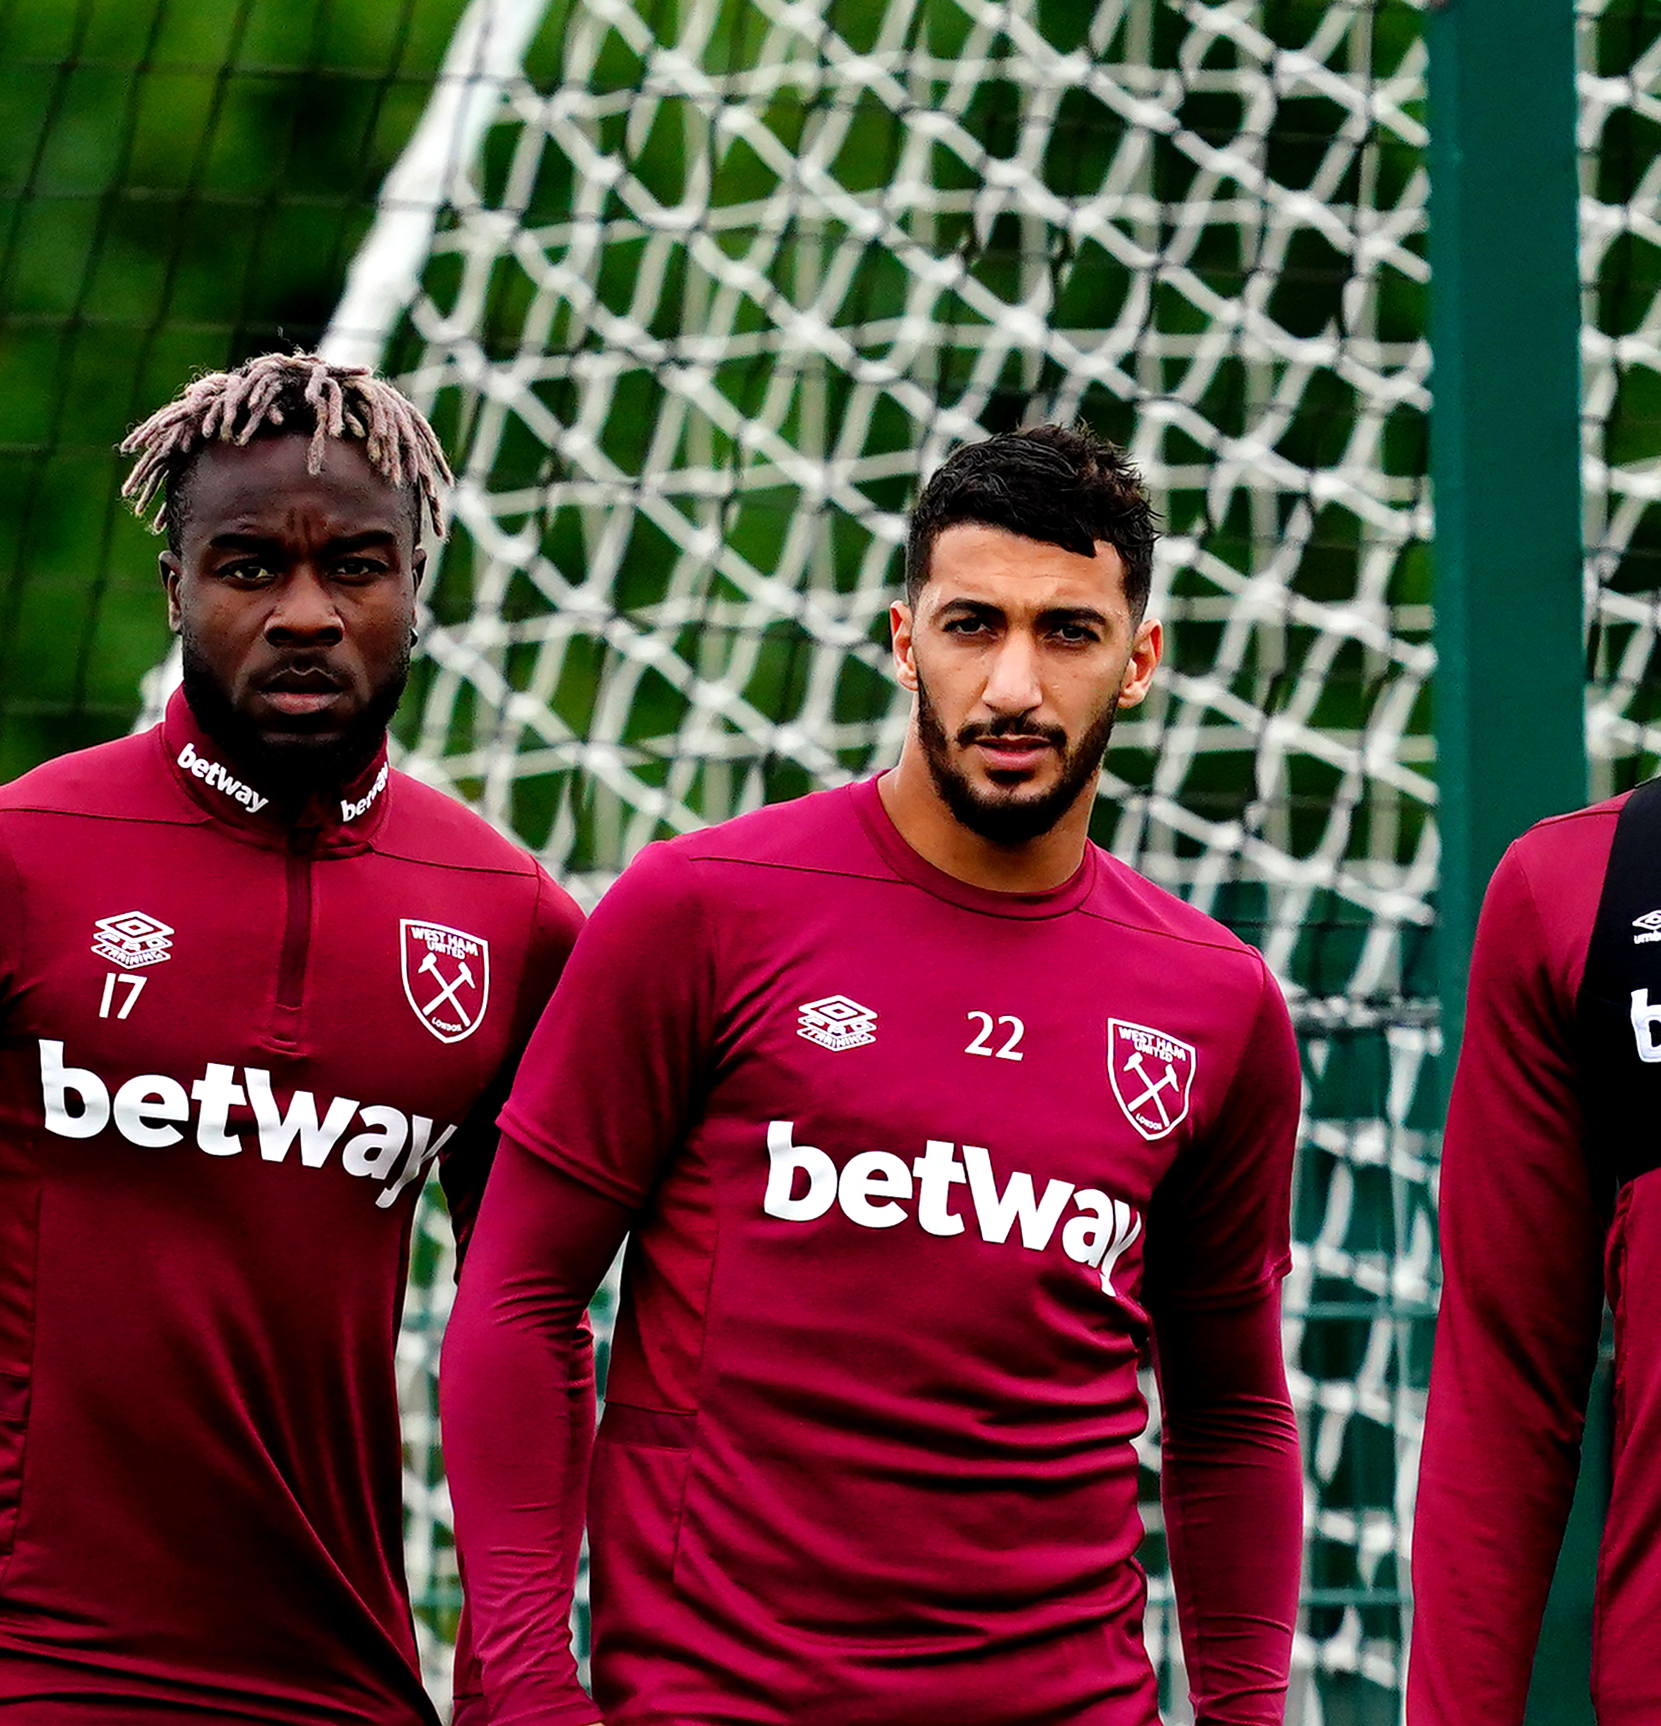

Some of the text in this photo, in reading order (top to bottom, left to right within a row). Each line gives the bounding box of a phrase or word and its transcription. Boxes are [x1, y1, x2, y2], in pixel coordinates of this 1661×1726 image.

[177, 742, 269, 813] betway
[410, 926, 479, 956] WEST HAM
[426, 940, 466, 960] UNITED
[98, 972, 148, 1020] 17
[964, 1011, 1025, 1061] 22
[1118, 1027, 1187, 1061] WEST HAM
[1133, 1039, 1173, 1062] UNITED
[38, 1039, 458, 1209] betway
[763, 1120, 1142, 1298] betway
